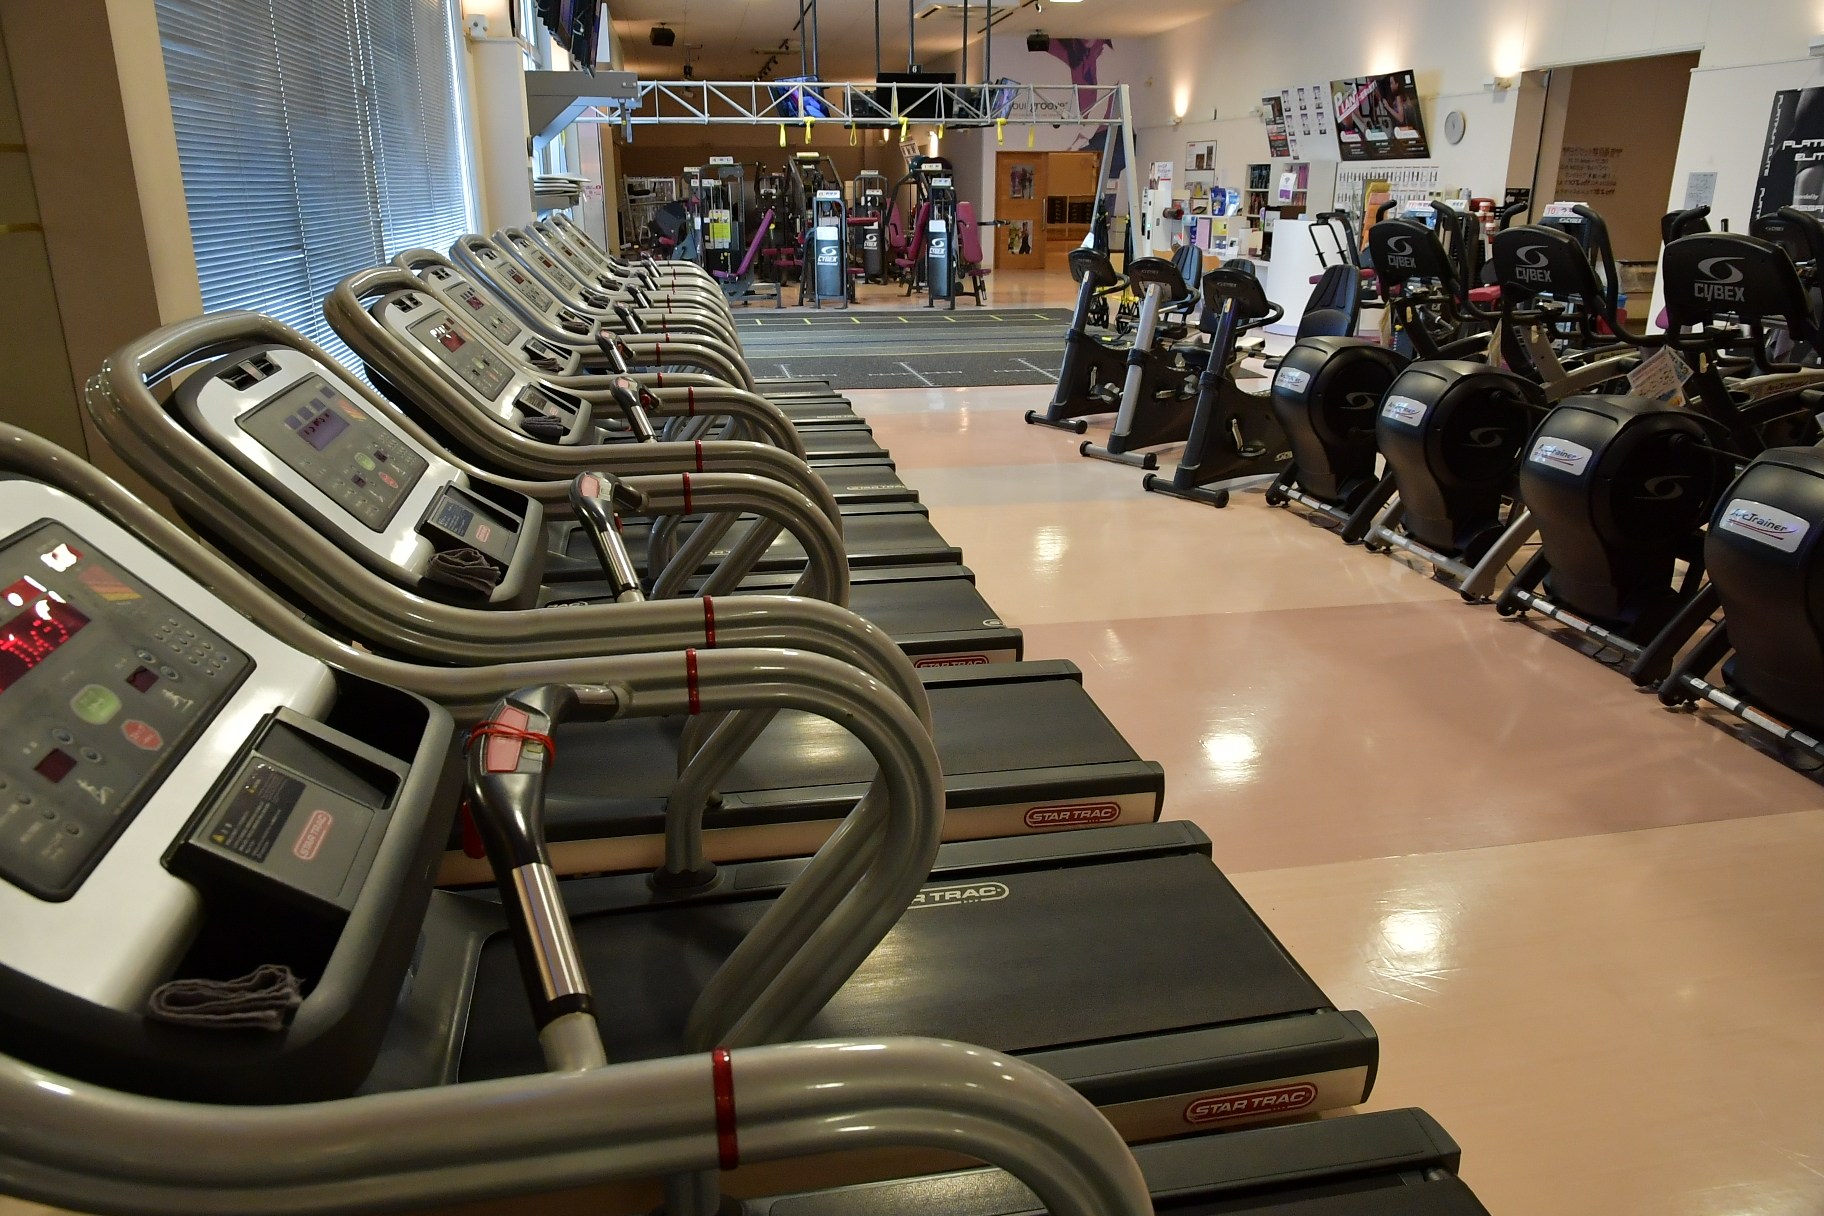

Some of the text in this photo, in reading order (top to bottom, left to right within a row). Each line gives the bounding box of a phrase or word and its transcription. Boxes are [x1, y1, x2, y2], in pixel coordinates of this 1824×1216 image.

[1388, 255, 1416, 269] CYBEX
[1516, 267, 1552, 283] CYBEX
[1694, 282, 1745, 302] CYBEX
[1032, 808, 1112, 821] STAR TRAC
[930, 886, 997, 901] TRAC
[1196, 1091, 1306, 1115] STAR TRAC
